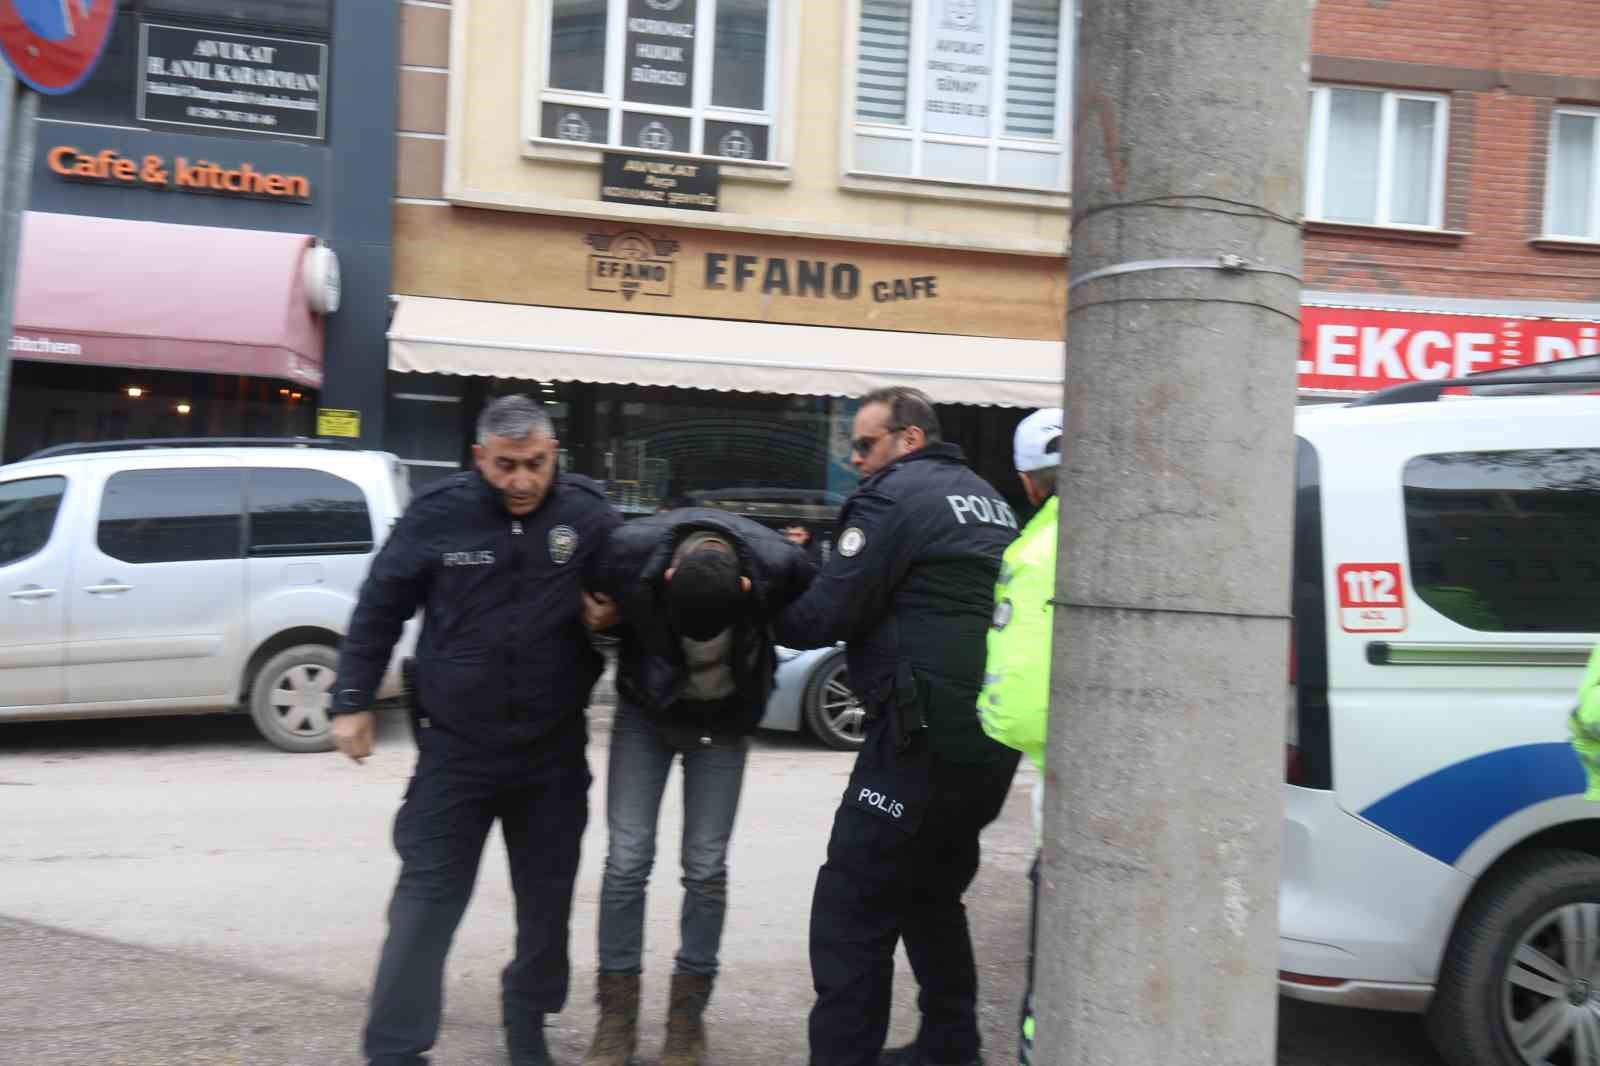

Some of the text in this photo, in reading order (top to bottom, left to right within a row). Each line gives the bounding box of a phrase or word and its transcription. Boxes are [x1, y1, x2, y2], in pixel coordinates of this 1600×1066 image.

[193, 39, 278, 64] AVUKAT
[635, 43, 684, 62] HUKUK
[48, 146, 310, 198] Cafe & kitchen
[624, 160, 699, 177] AVUKAT
[597, 261, 666, 283] EFANO
[705, 252, 938, 304] EFANO CAFE
[1297, 324, 1496, 381] EKCE
[1343, 569, 1400, 603] 112
